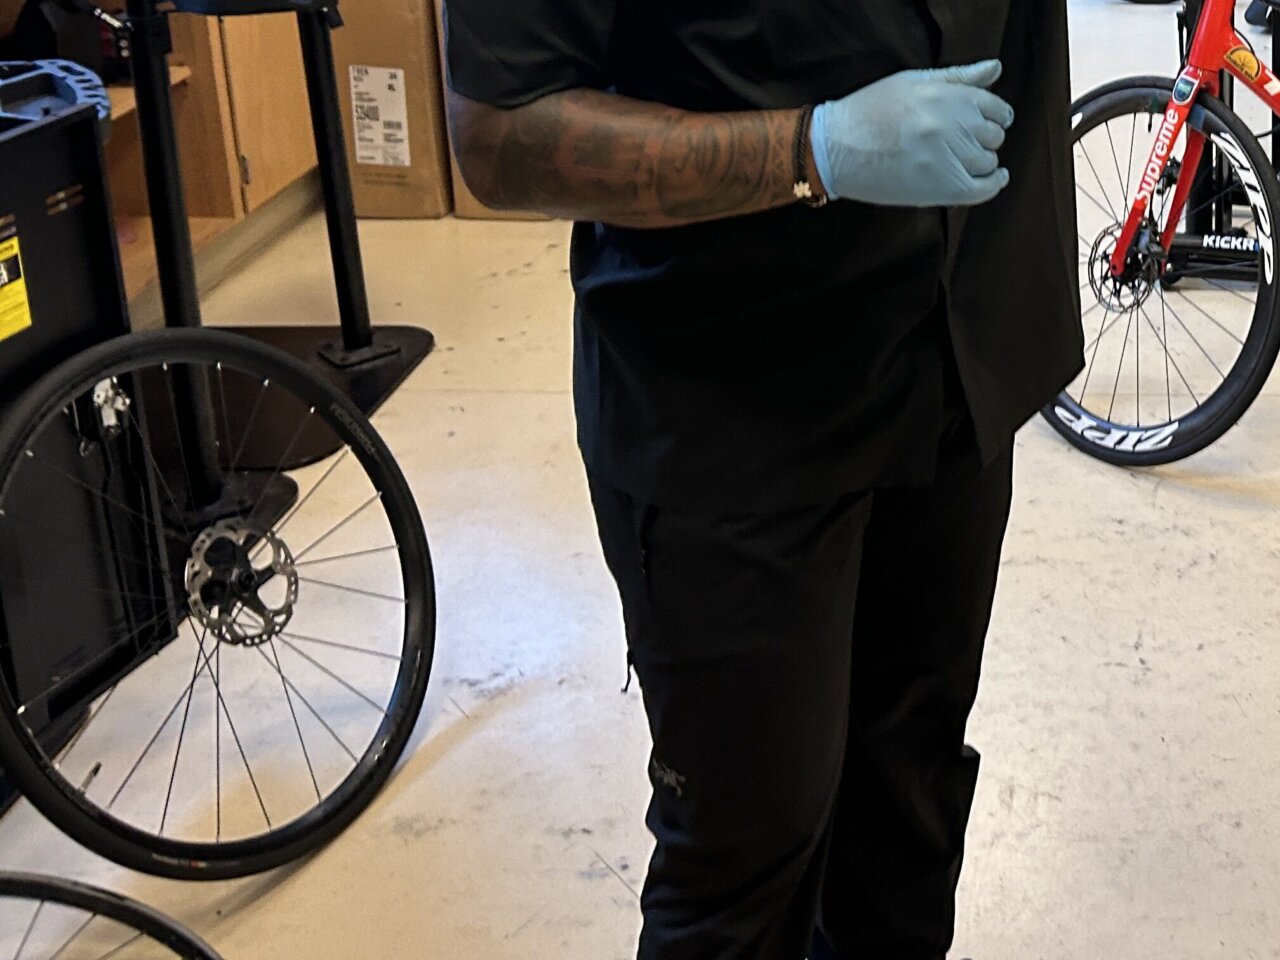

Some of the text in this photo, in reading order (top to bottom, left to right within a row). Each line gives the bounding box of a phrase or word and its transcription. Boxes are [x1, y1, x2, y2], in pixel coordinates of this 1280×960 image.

[1134, 108, 1179, 201] Supreme
[1202, 234, 1255, 252] KICKR
[1210, 131, 1274, 285] ZIPP
[1054, 405, 1179, 453] ZIPP
